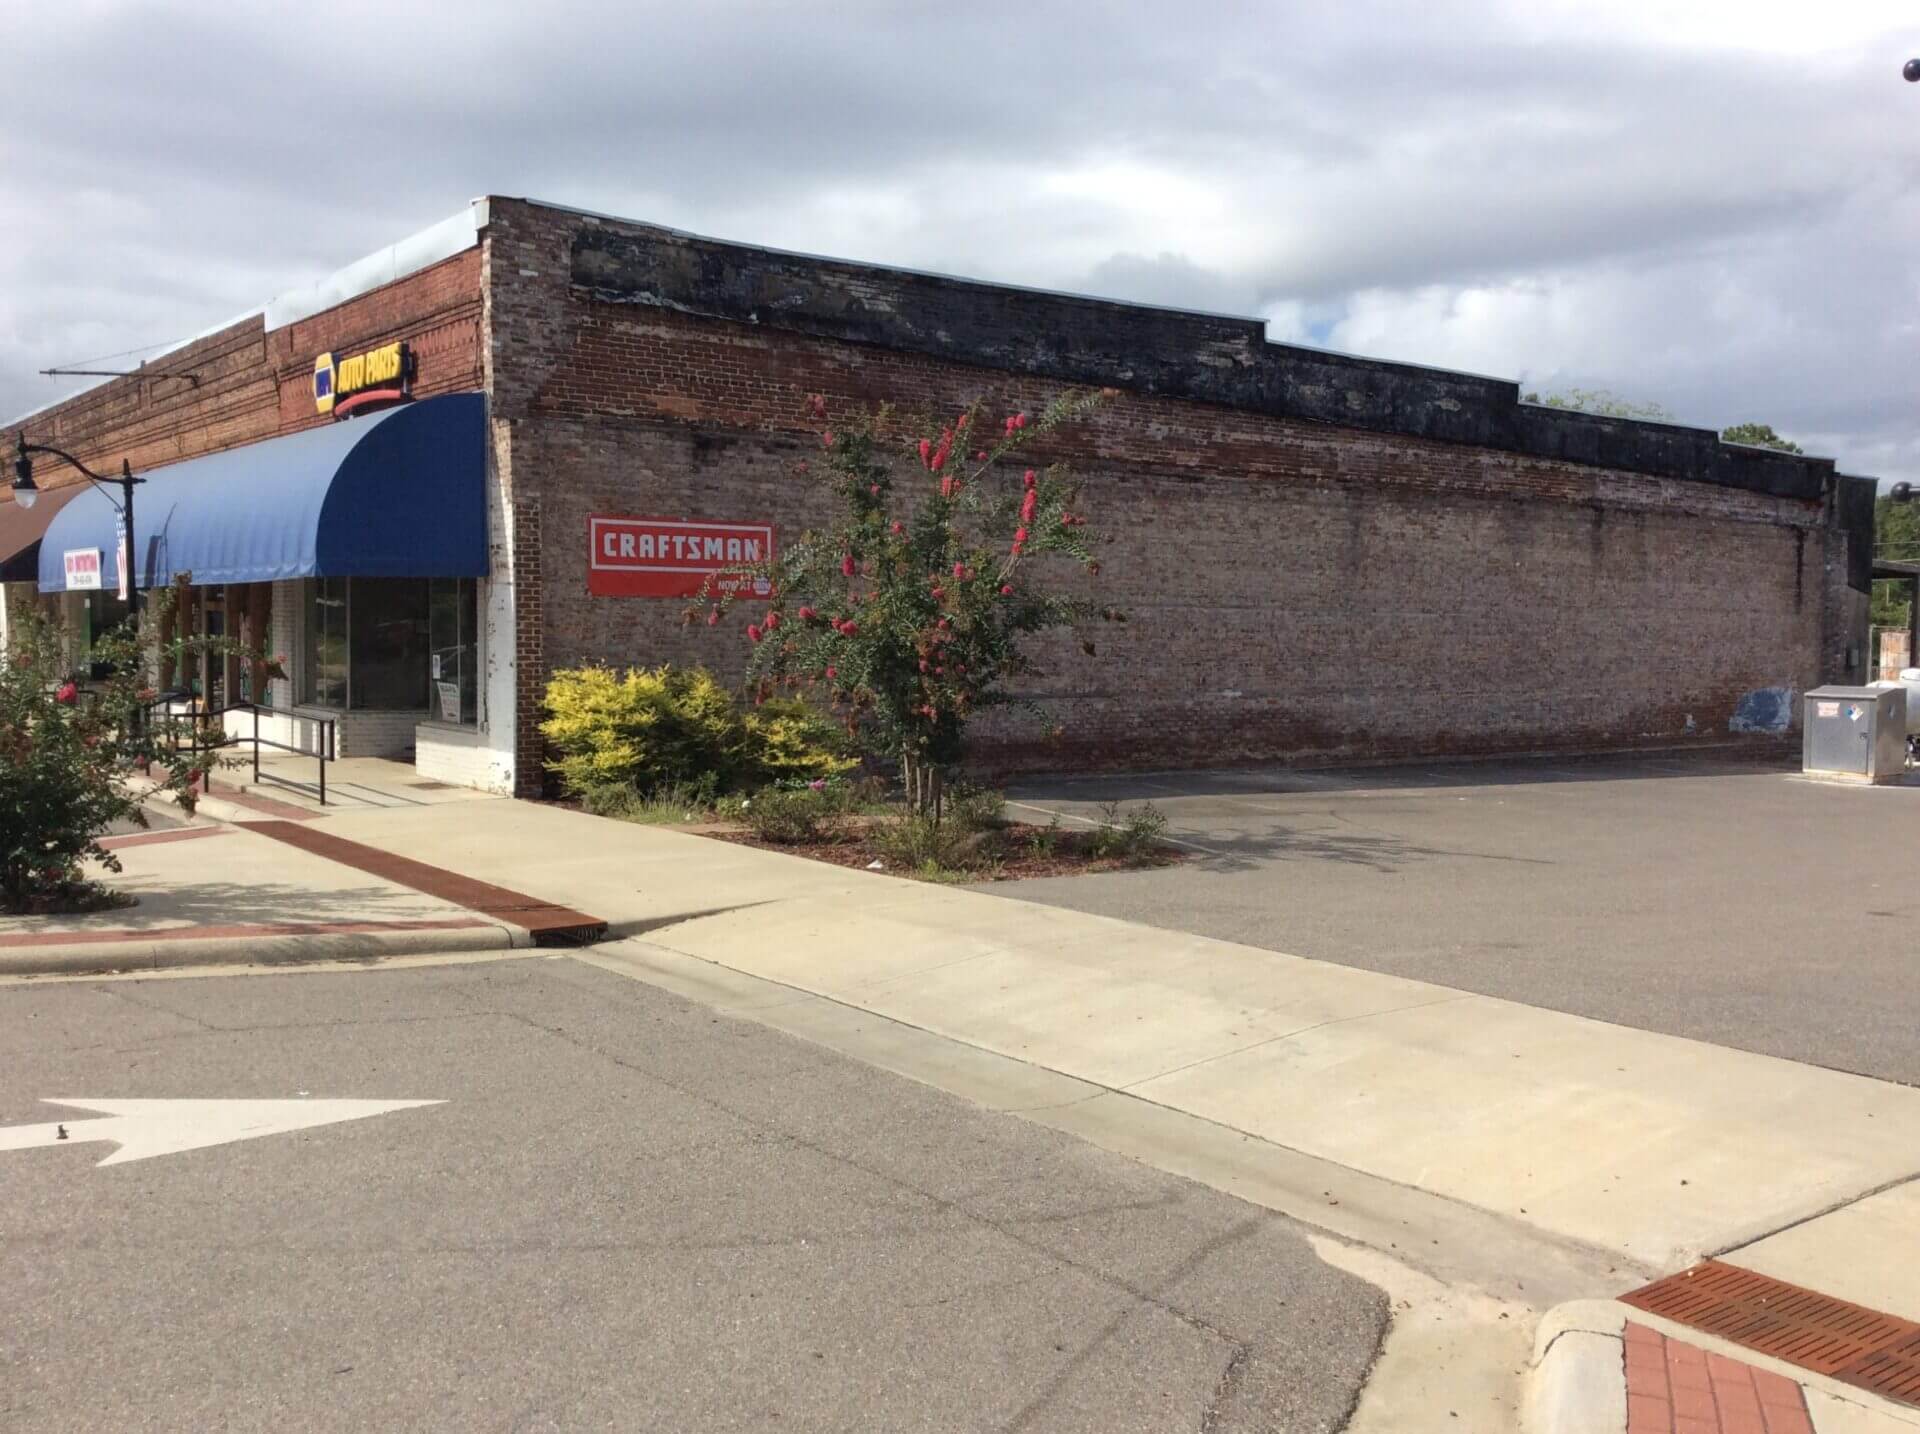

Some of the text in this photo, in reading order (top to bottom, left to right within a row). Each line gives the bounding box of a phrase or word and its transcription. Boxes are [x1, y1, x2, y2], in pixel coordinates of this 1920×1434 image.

[337, 354, 365, 394] AUTO
[365, 342, 401, 386] PARTS
[603, 532, 761, 561] CRAFTSMAN
[718, 580, 738, 592] NOW
